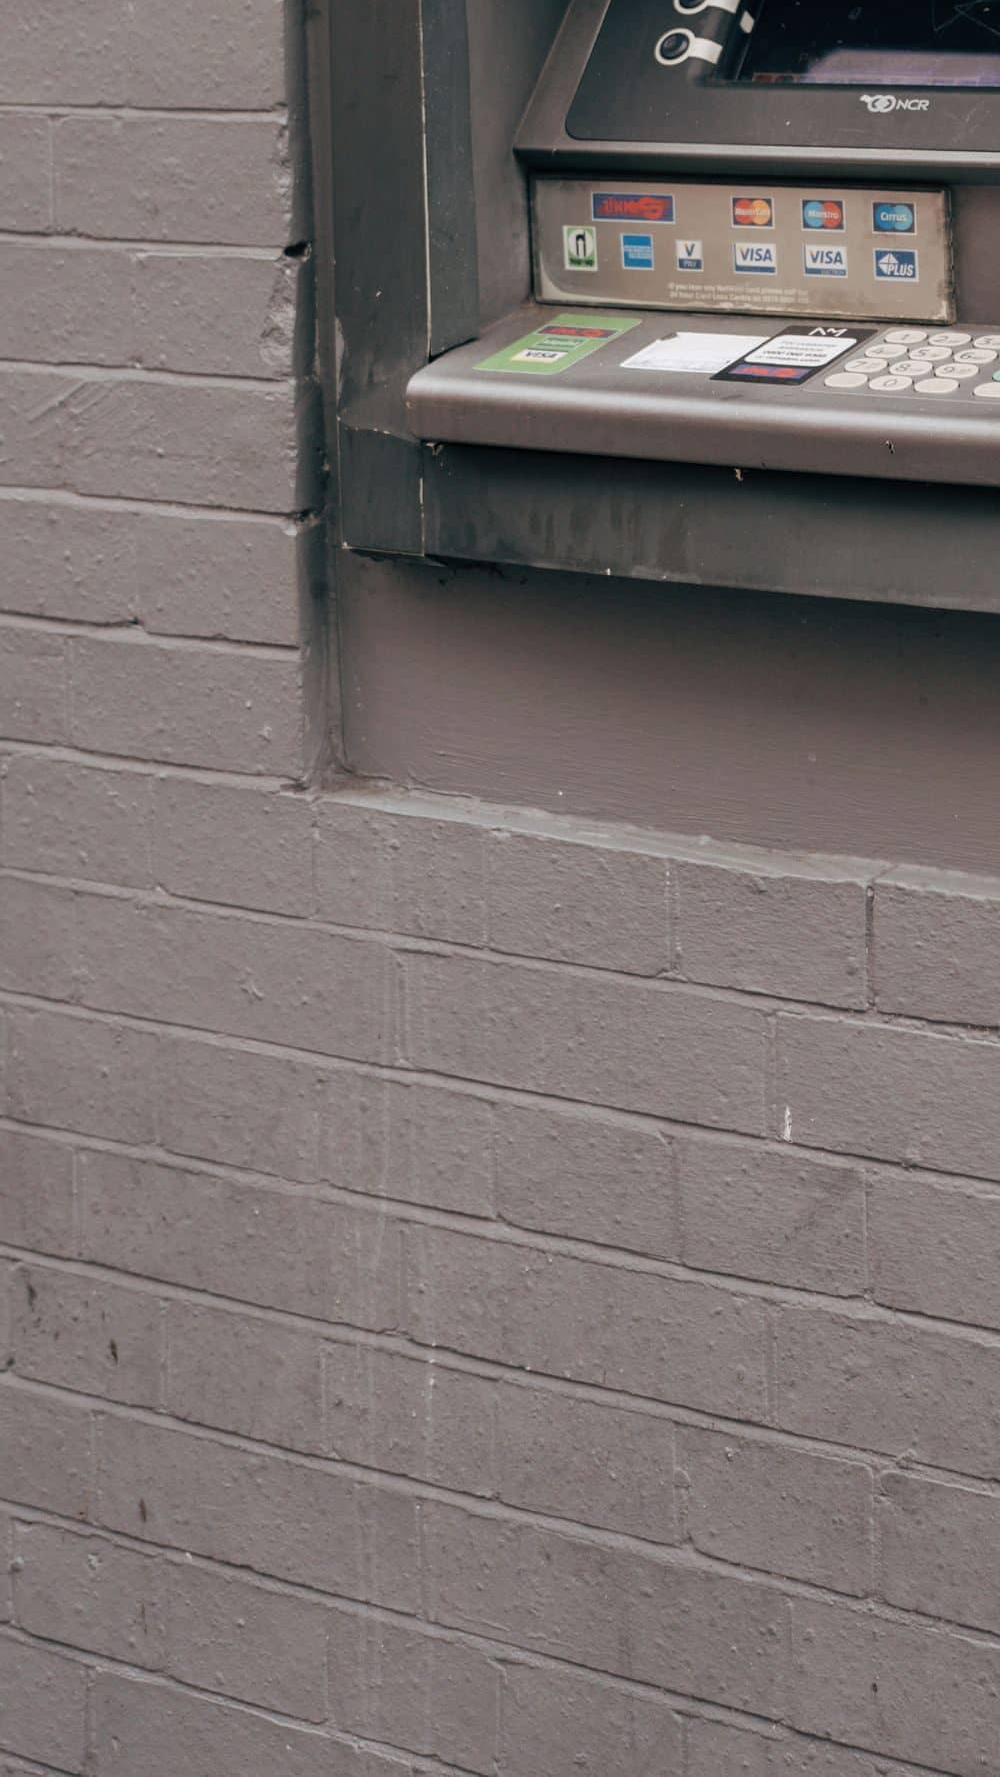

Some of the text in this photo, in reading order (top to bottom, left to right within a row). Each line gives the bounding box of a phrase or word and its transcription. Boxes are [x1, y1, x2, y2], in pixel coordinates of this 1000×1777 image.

[896, 98, 931, 111] NCR
[880, 211, 908, 223] Cirrus
[739, 248, 773, 262] VISA
[809, 250, 844, 265] VISA
[887, 263, 914, 277] PLUS
